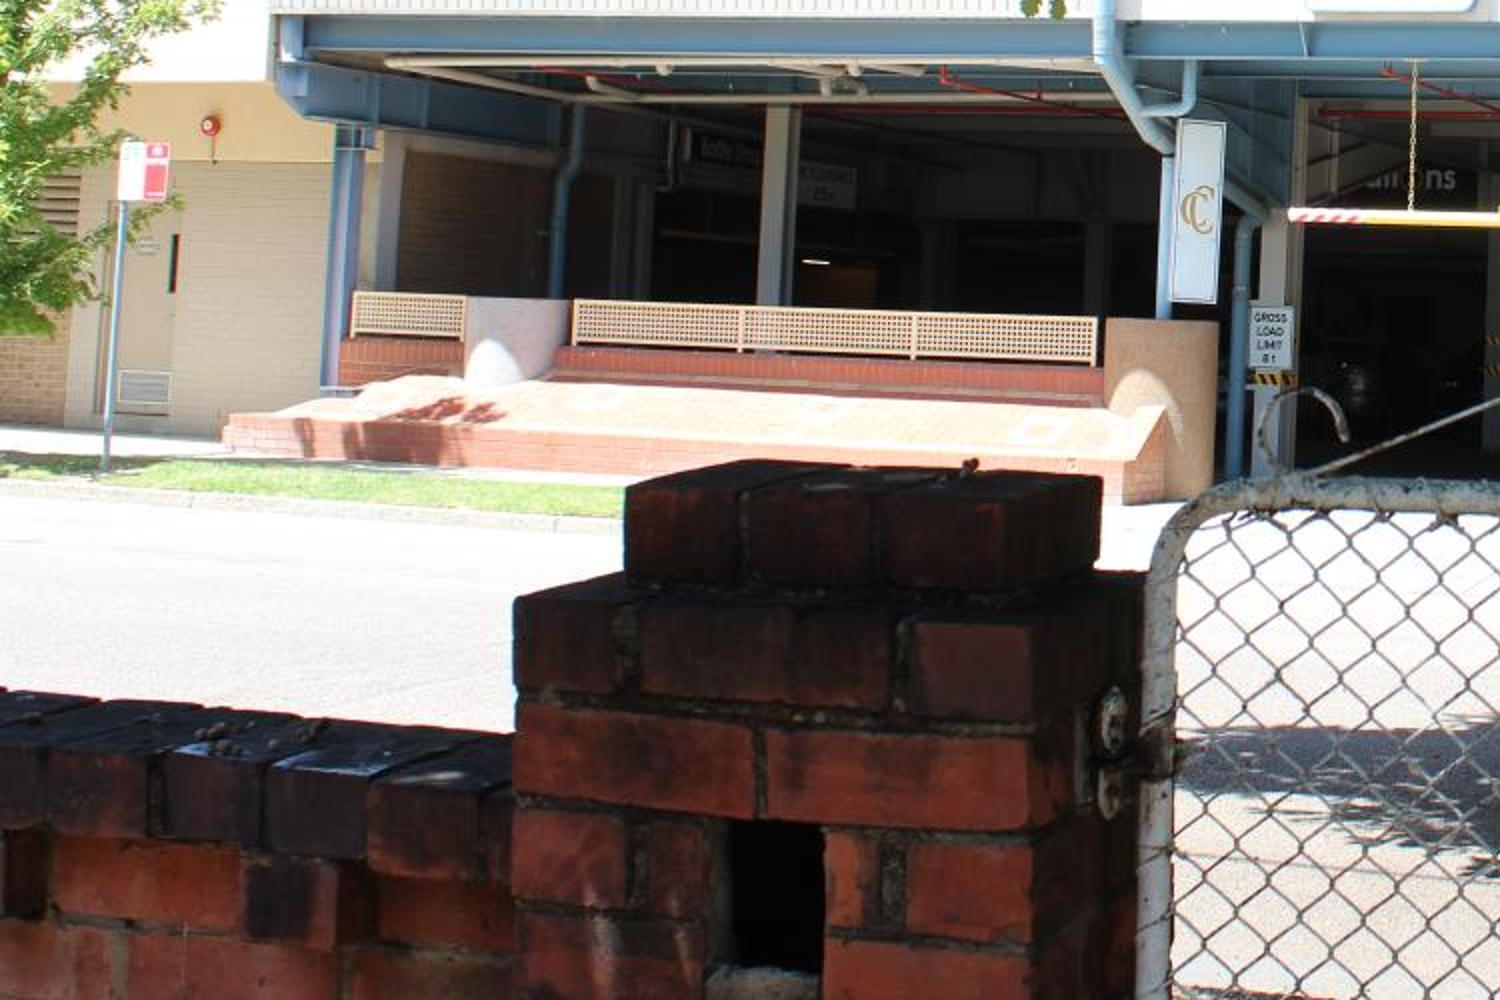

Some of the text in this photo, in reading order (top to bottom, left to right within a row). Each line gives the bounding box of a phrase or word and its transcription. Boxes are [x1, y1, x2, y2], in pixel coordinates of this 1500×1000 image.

[1254, 311, 1288, 323] GROSS
[1256, 325, 1285, 337] LOAD
[1257, 339, 1283, 350] LIMIT
